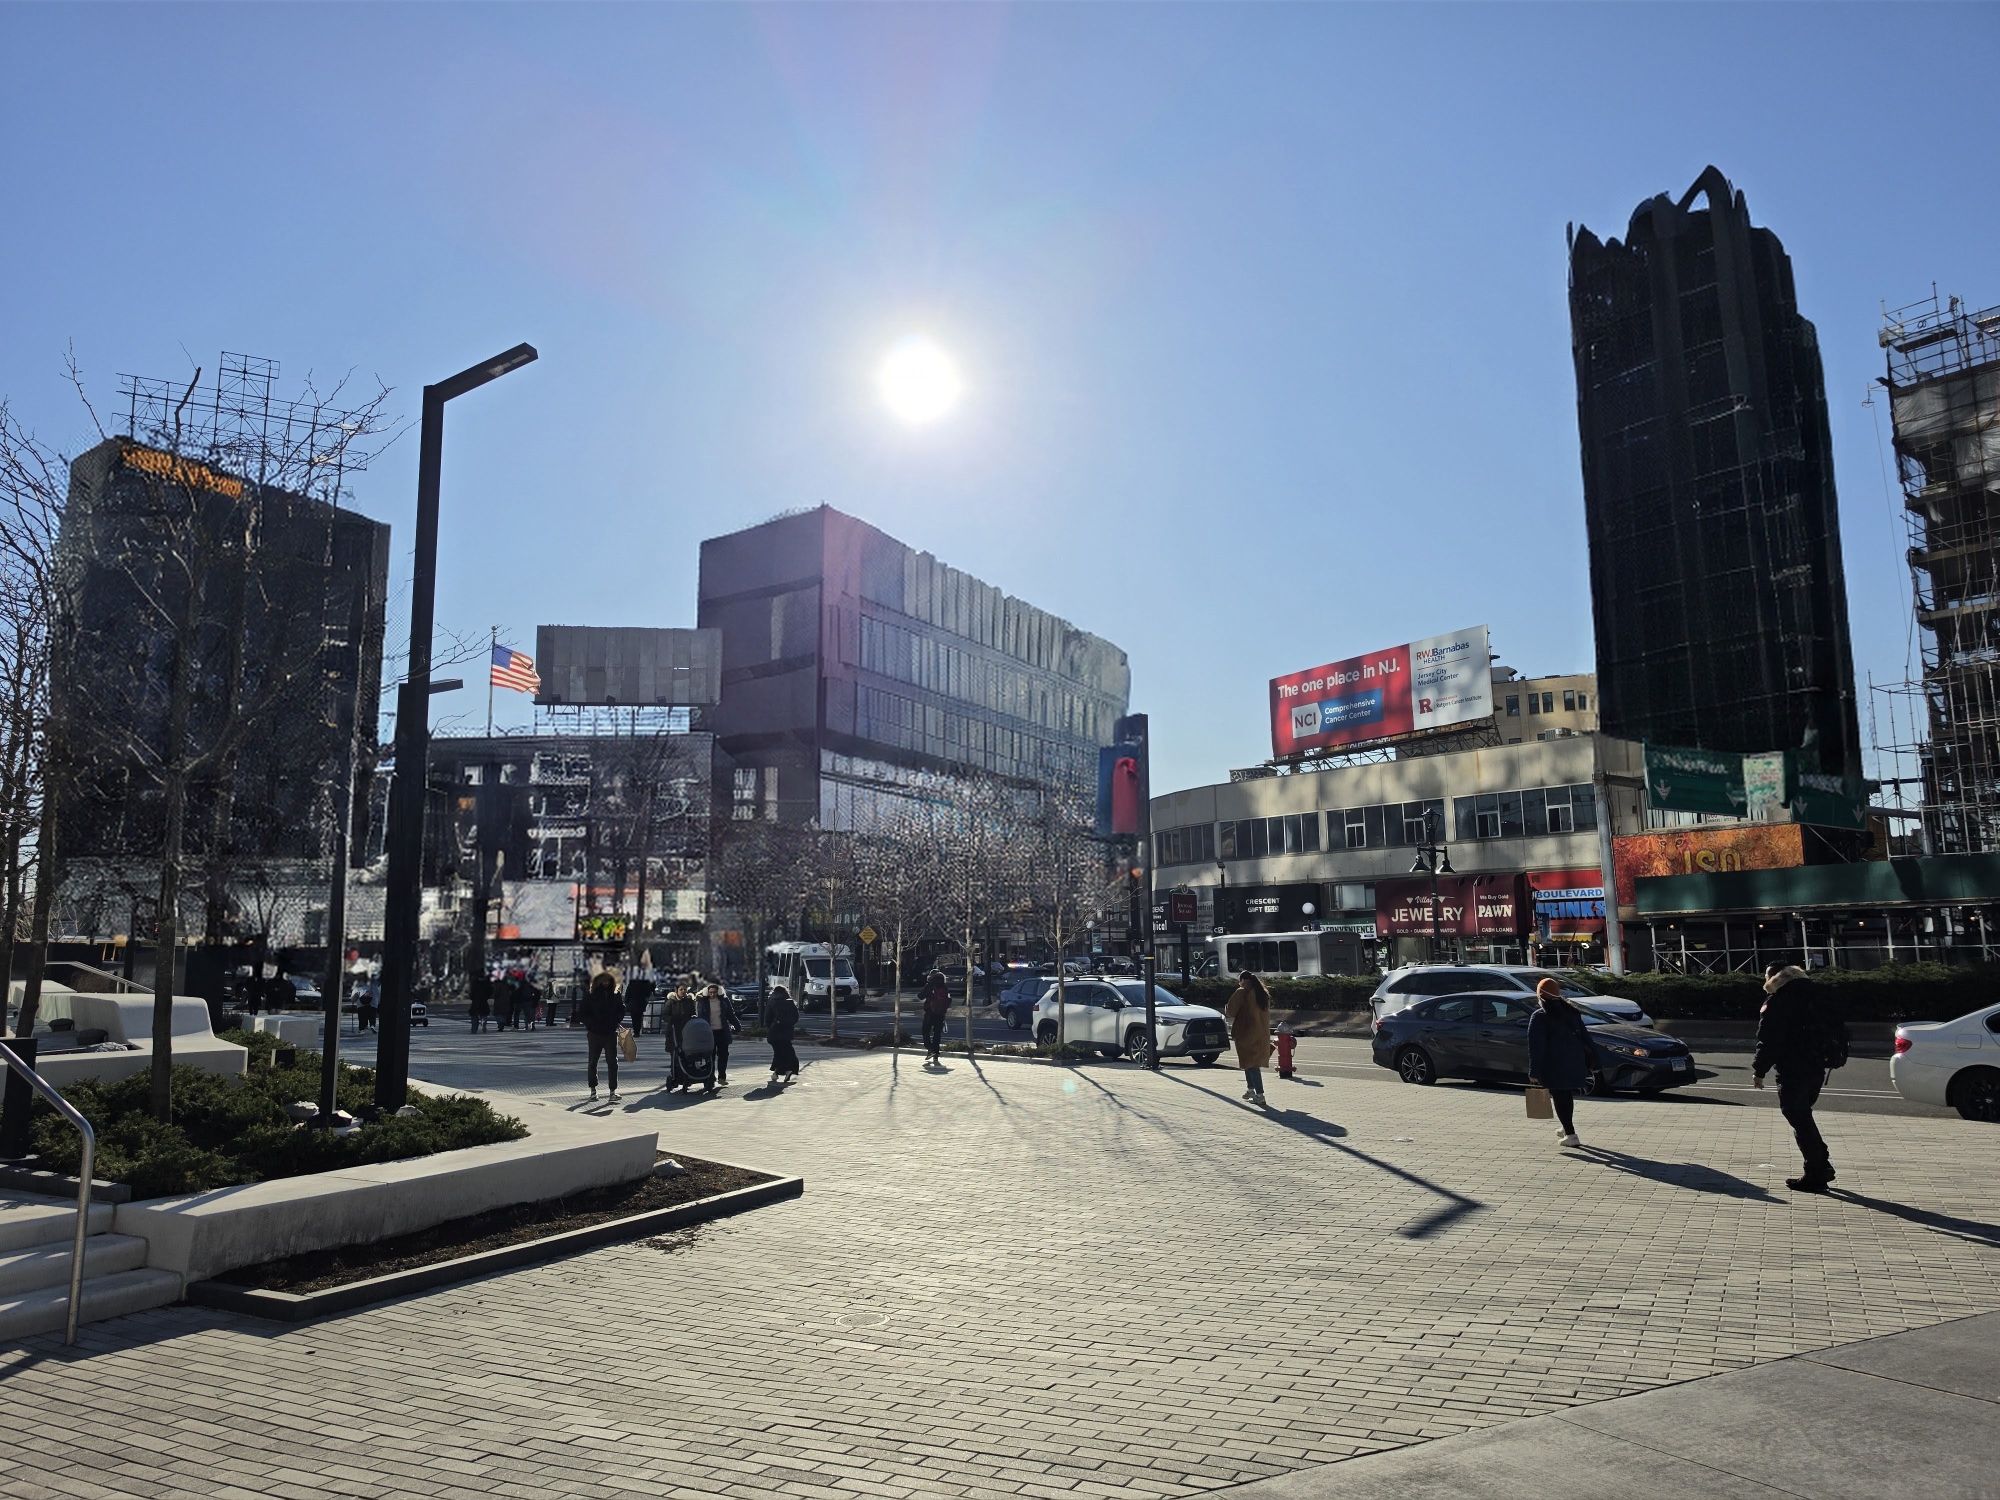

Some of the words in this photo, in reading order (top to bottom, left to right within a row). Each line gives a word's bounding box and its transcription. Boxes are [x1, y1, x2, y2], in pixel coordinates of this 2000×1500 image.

[1416, 642, 1470, 661] RWJBarnabas
[1423, 655, 1446, 664] HEALTH
[1278, 684, 1299, 698] The
[1302, 680, 1324, 693] one
[1327, 670, 1360, 689] place
[1363, 664, 1375, 679] in
[1379, 657, 1401, 676] NJ.
[1417, 671, 1435, 679] Jersey
[1436, 668, 1448, 676] City
[1418, 678, 1439, 687] Medical
[1440, 673, 1460, 682] Center
[1324, 698, 1376, 715] Comprehensive
[1295, 711, 1317, 729] NCI
[1325, 715, 1348, 724] Cancer
[1348, 709, 1372, 720] Center
[1536, 888, 1603, 899] BOULEVARD
[1245, 897, 1280, 905] CRESCENT
[1391, 907, 1463, 922] JEWERY
[1478, 904, 1513, 918] PAWN
